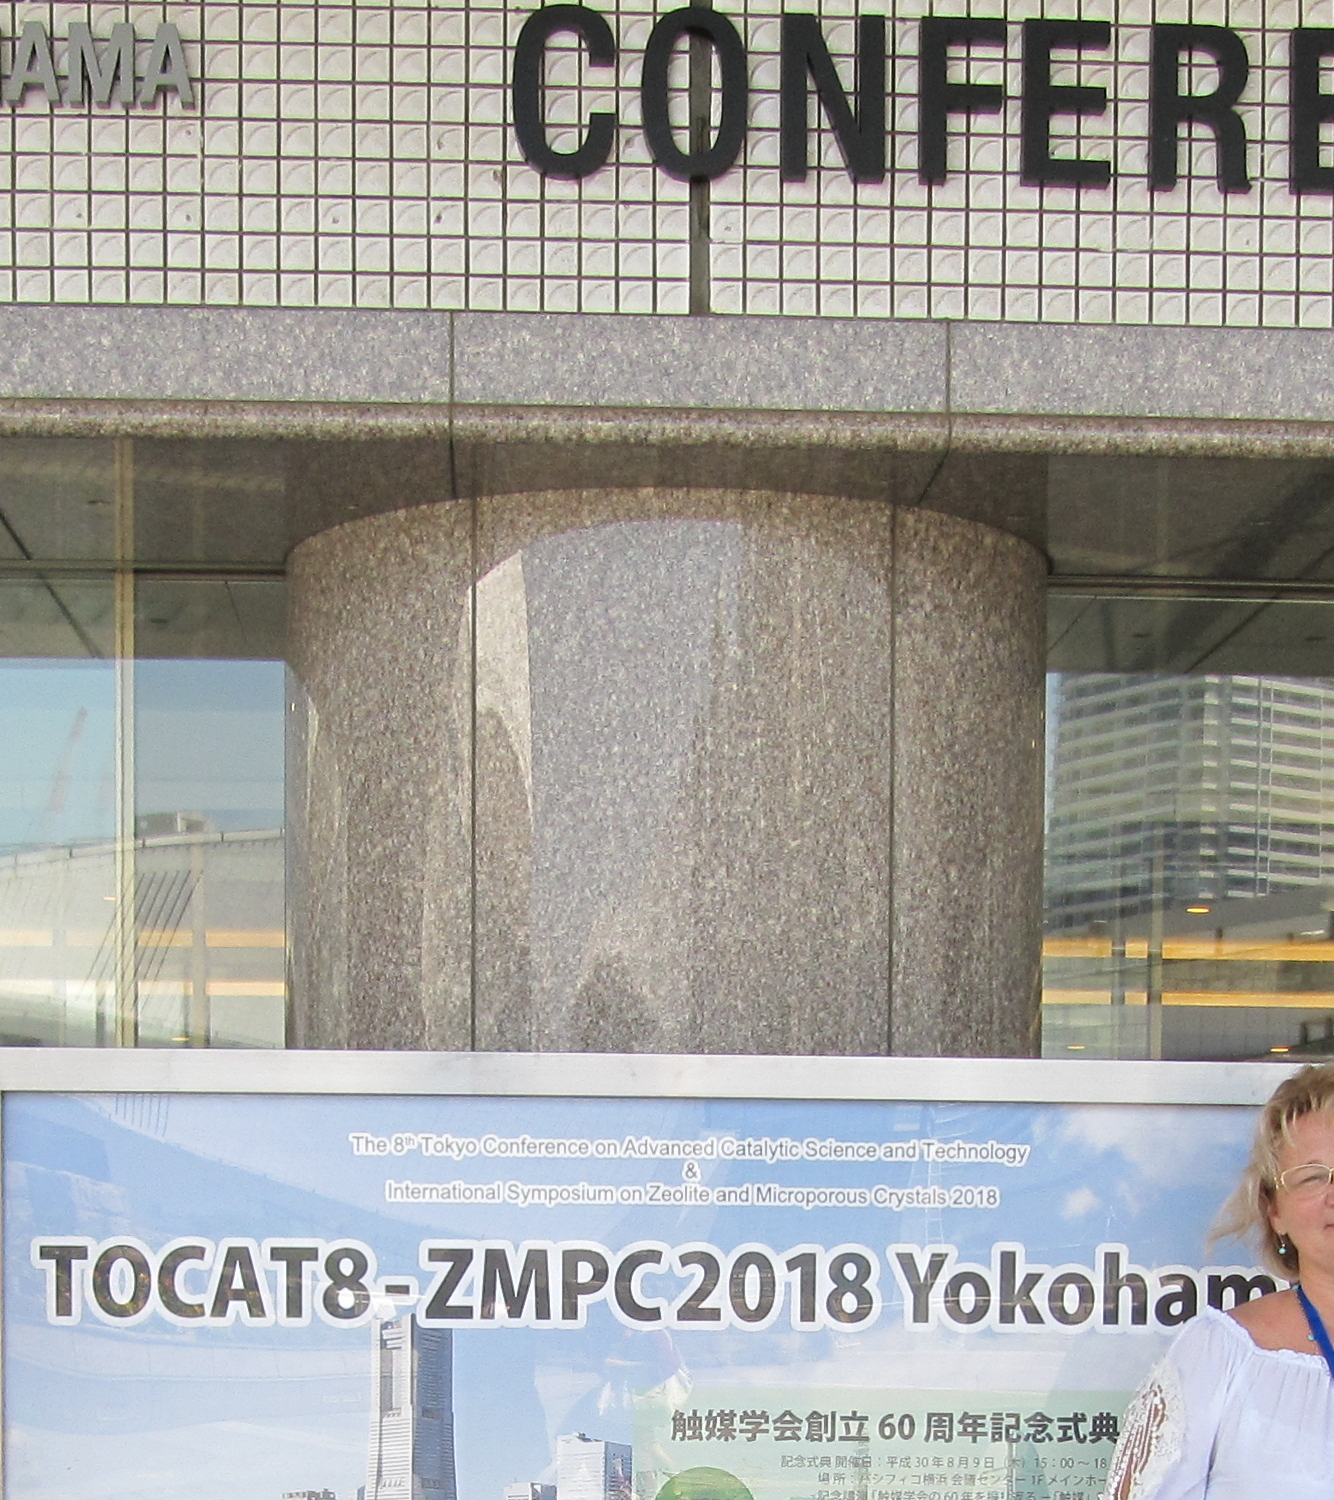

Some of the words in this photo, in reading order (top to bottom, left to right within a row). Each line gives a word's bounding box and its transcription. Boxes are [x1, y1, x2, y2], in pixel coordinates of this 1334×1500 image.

[352, 1137, 387, 1152] The
[393, 1137, 416, 1153] 8th
[422, 1137, 477, 1158] Tokyo
[483, 1137, 589, 1155] Conference
[594, 1142, 618, 1155] on
[623, 1139, 714, 1156] Advanced
[721, 1140, 799, 1161] Catalytic
[802, 1141, 877, 1158] Science
[883, 1142, 917, 1159] and
[923, 1142, 1028, 1164] Technology
[685, 1162, 700, 1179] &
[388, 1182, 501, 1200] International
[507, 1184, 614, 1205] Symposium
[620, 1190, 643, 1202] on
[649, 1185, 710, 1203] Zeolite
[716, 1187, 749, 1204] and
[757, 1187, 867, 1208] Microporous
[874, 1187, 946, 1209] Crystals
[951, 1189, 999, 1206] 2018
[39, 1244, 875, 1325] TOCAT8-ZMPC2018
[895, 1249, 1274, 1327] Yokoham
[671, 1408, 870, 1443] 触媒学会創立
[923, 1411, 1120, 1444] 周年記念式典
